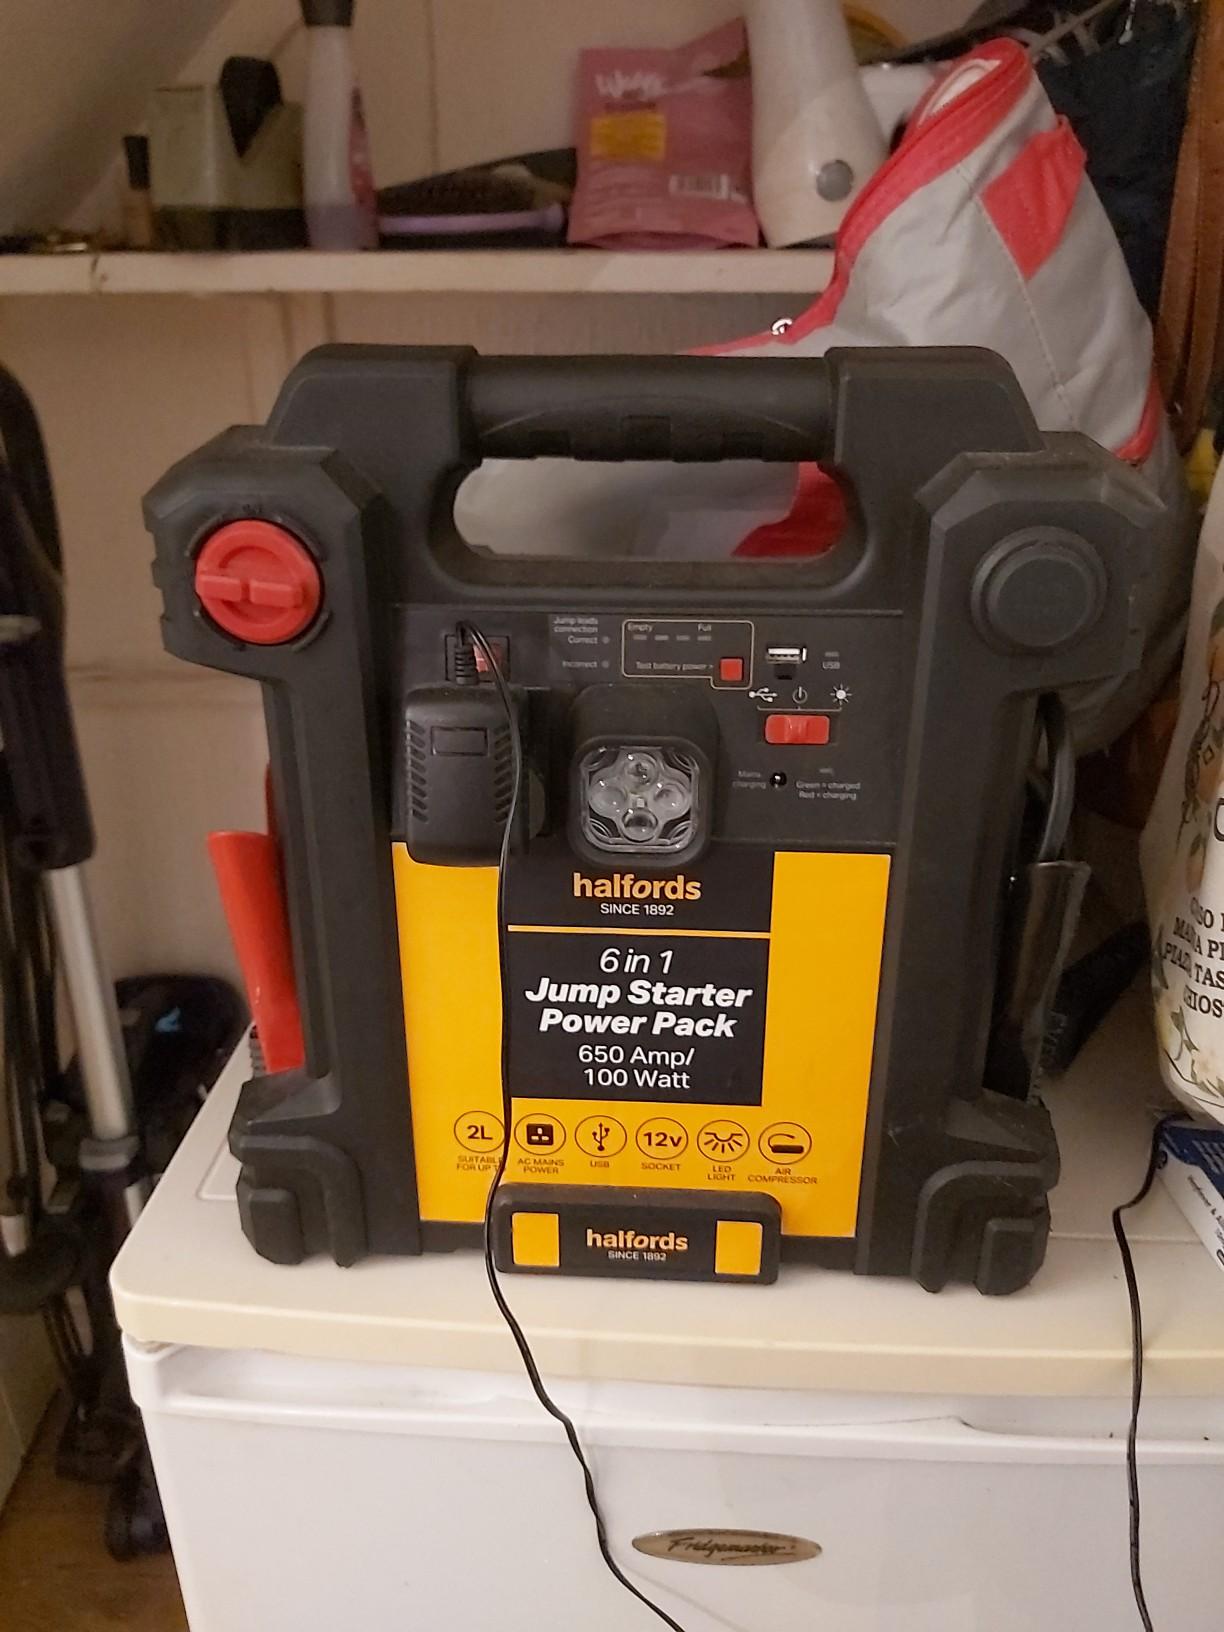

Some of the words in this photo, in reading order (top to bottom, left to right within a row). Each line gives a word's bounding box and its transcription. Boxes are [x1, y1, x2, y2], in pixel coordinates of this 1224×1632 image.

[553, 616, 576, 625] Jump
[627, 622, 652, 632] Empty
[697, 623, 712, 632] Full
[567, 635, 598, 644] Correct
[562, 660, 598, 668] Incorrect
[636, 661, 652, 669] Test
[652, 662, 680, 671] battery
[682, 663, 707, 671] power
[822, 661, 841, 670] USB
[732, 780, 767, 789] charging
[796, 780, 820, 789] Green
[827, 782, 860, 791] charged
[799, 790, 815, 798] Red
[822, 792, 856, 801] charging
[573, 872, 702, 900] halfords
[600, 903, 640, 915] SINCE
[643, 904, 675, 916] 1892
[600, 947, 621, 973] 6
[624, 948, 651, 974] in
[659, 950, 674, 974] 1
[525, 977, 622, 1009] Jump
[627, 979, 754, 1008] Starter
[539, 1008, 648, 1035] Power
[651, 1011, 738, 1038] Pack
[578, 1044, 625, 1064] 650
[630, 1046, 695, 1069] Amp/
[584, 1068, 628, 1087] 100
[633, 1069, 691, 1089] Watt
[466, 1124, 493, 1141] 2L
[457, 1162, 476, 1171] FOR
[477, 1164, 492, 1172] UP
[533, 1158, 565, 1167] MAINS
[590, 1160, 610, 1169] USB
[641, 1162, 681, 1171] SOCKET
[523, 1166, 559, 1175] POWER
[712, 1165, 732, 1173] LED
[775, 1167, 792, 1176] AIR
[707, 1173, 736, 1182] LIGHT
[748, 1174, 818, 1185] COMPRESSOR
[586, 1228, 689, 1251] halfords
[608, 1250, 639, 1261] SINCE
[643, 1251, 667, 1262] 1892
